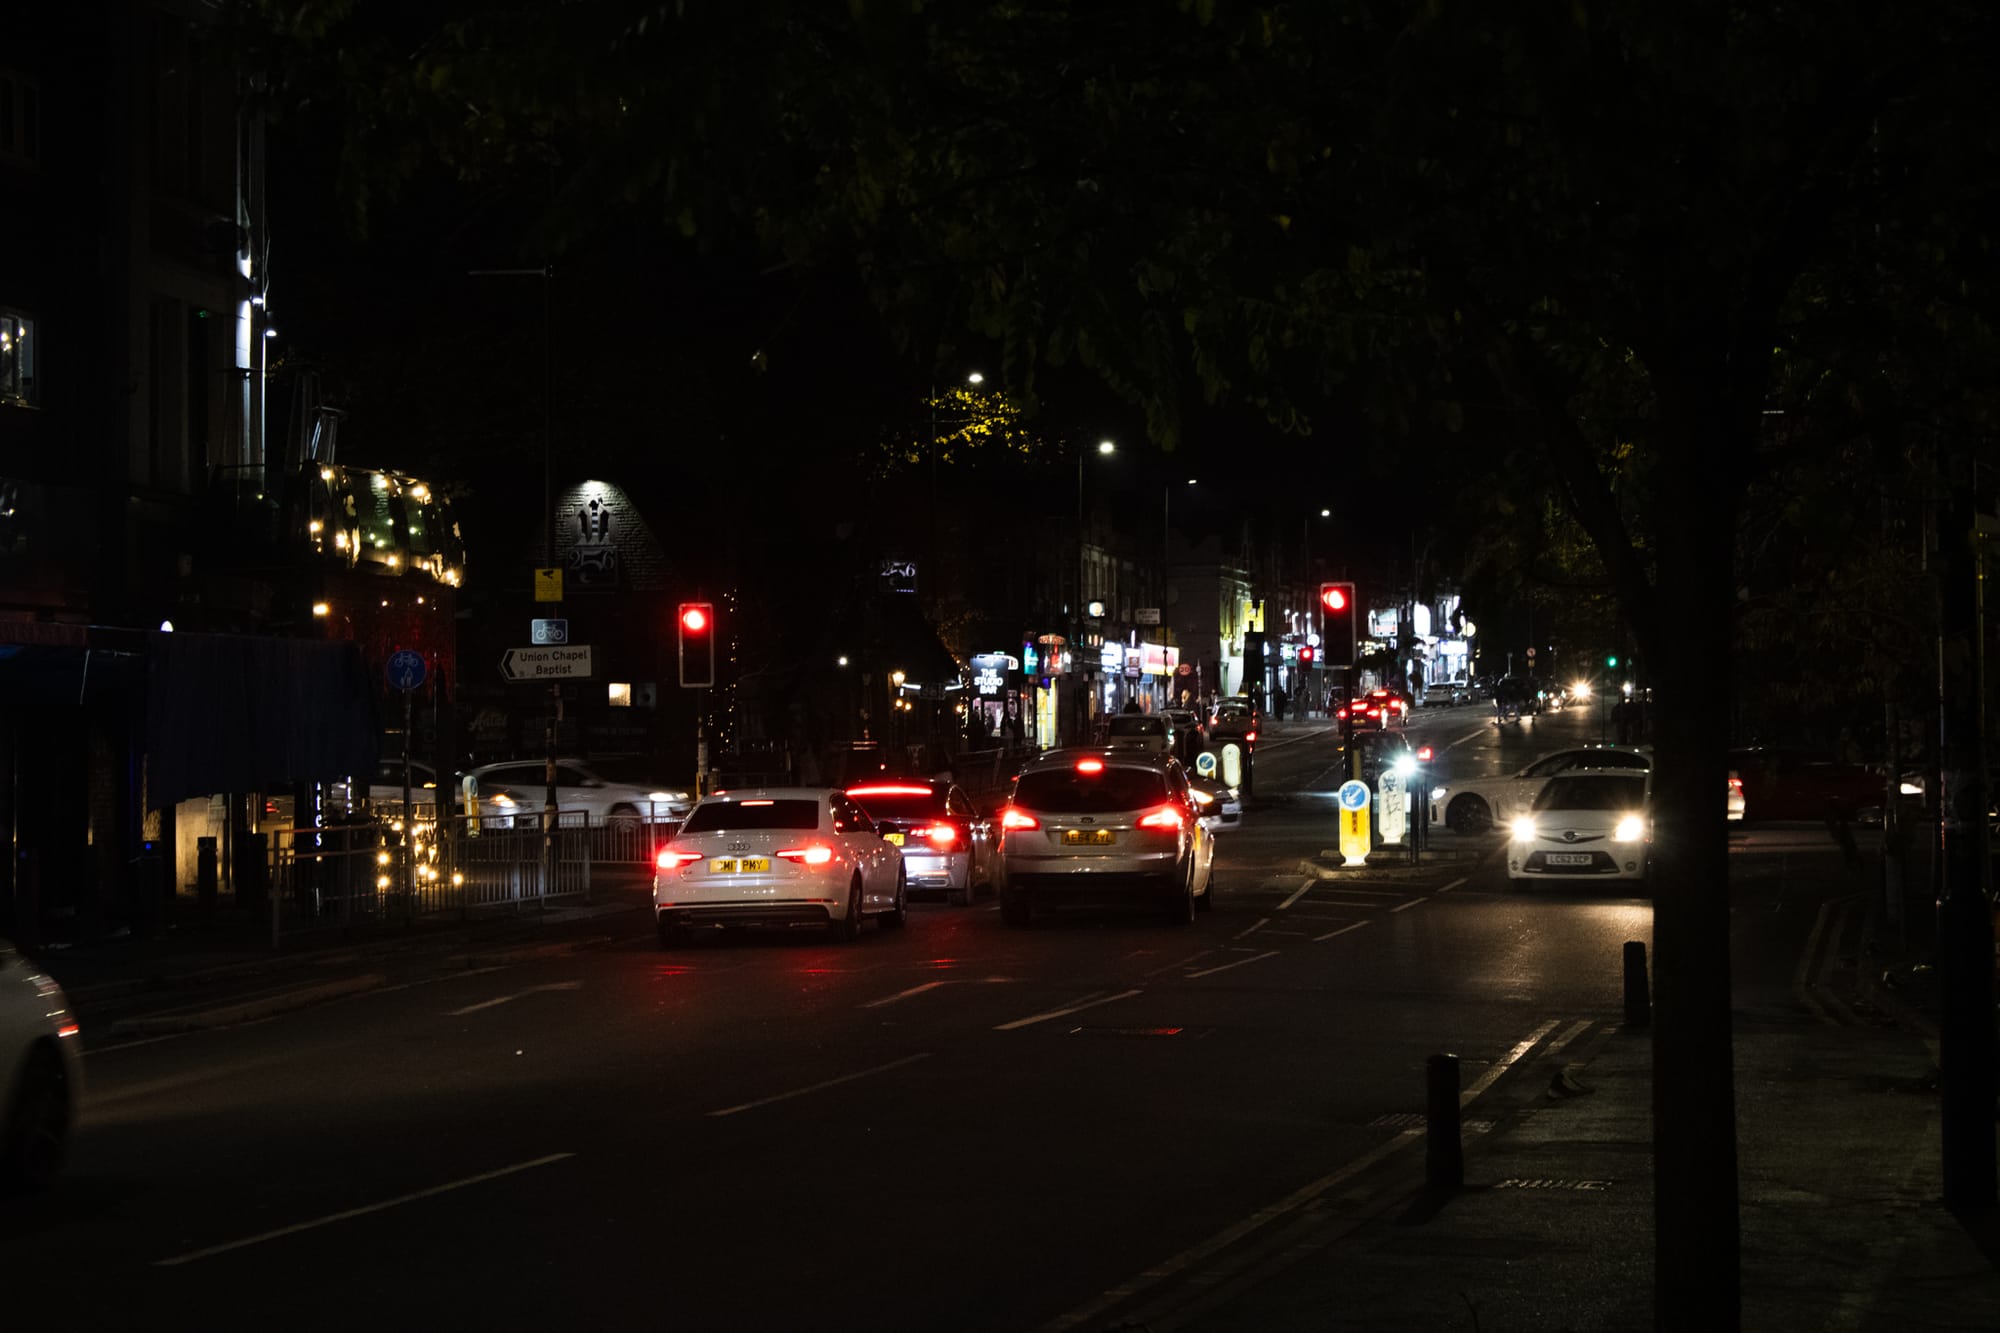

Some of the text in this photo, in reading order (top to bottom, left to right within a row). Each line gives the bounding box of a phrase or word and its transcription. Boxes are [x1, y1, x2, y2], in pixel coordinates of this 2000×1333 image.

[569, 549, 615, 584] 256
[520, 649, 588, 662] Union Chapel
[536, 664, 572, 675] Baptist
[981, 668, 997, 677] THE
[974, 677, 1003, 686] STUDIO
[980, 686, 997, 694] BAR
[742, 860, 762, 871] PMY
